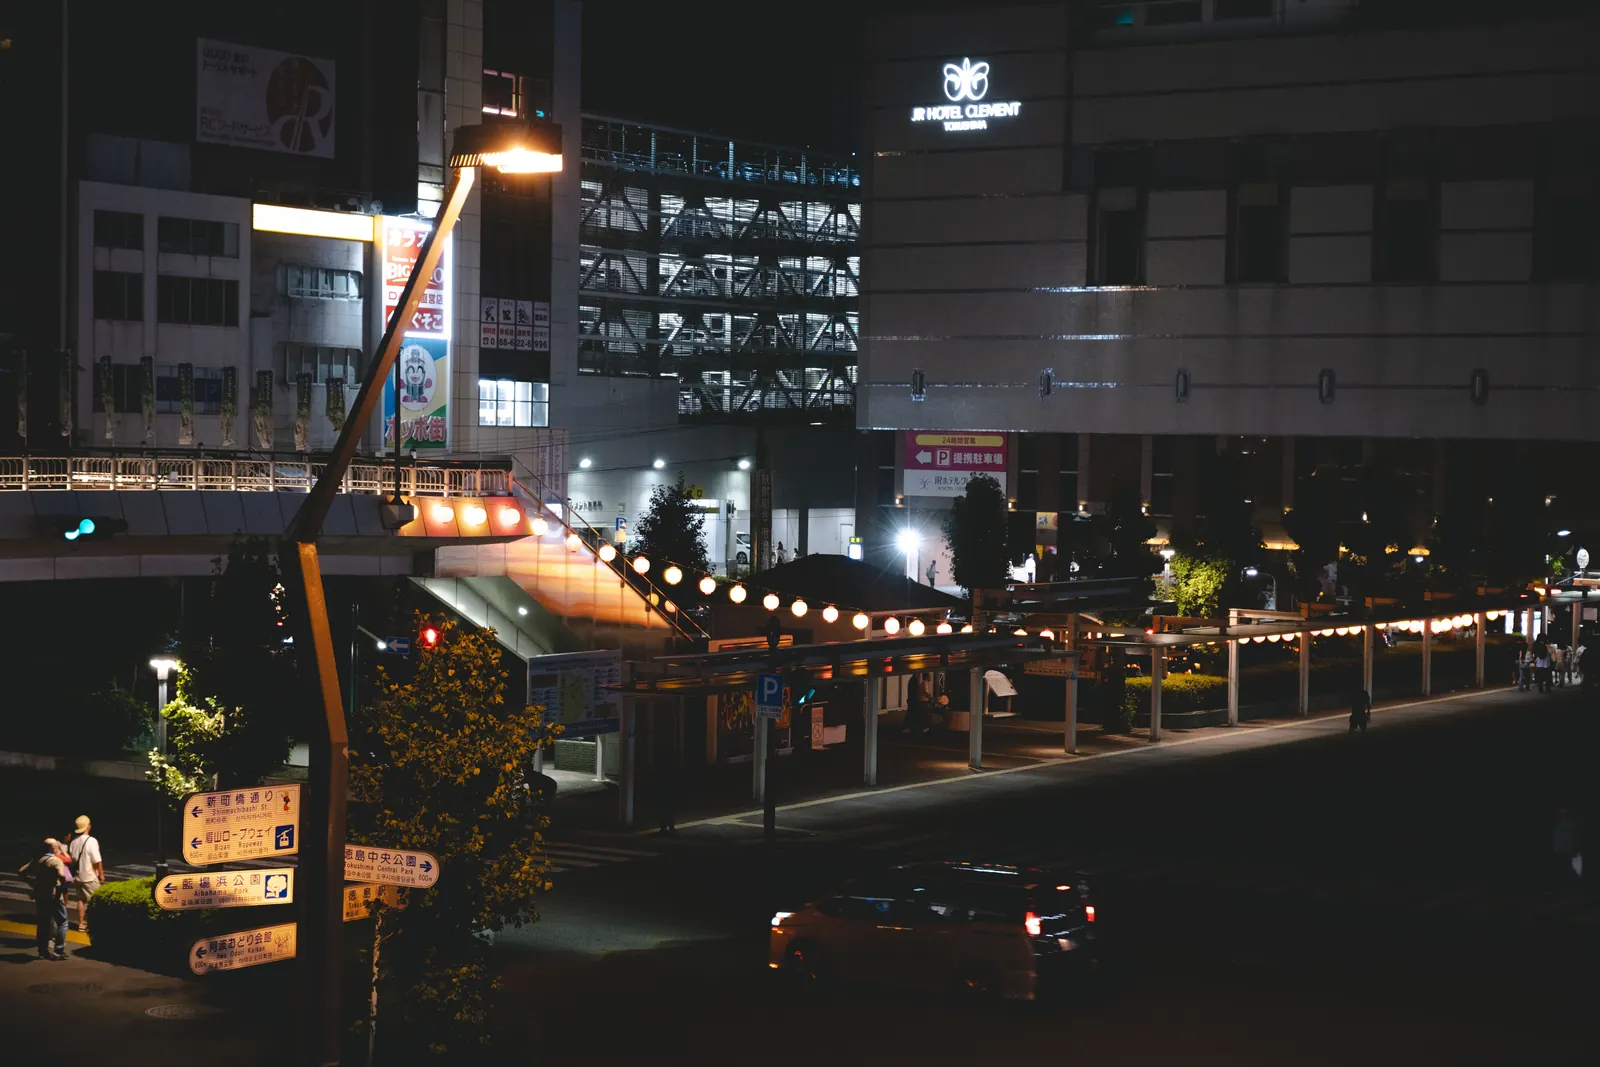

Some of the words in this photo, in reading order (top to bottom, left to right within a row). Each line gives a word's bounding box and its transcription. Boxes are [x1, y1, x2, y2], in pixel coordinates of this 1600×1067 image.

[911, 107, 925, 121] JR
[927, 105, 963, 120] HOTEL
[965, 102, 1021, 118] CLEMENT
[763, 676, 779, 702] P
[207, 790, 273, 807] 新町橋通り
[206, 826, 272, 844] 眉山ロープウェイ
[214, 843, 231, 851] Bizan
[238, 841, 263, 850] Ropeway
[377, 865, 398, 874] Central
[401, 867, 414, 875] Park
[182, 874, 261, 890] 藍場浜公園
[193, 890, 226, 898] Aibahama
[233, 887, 249, 895] Park
[209, 931, 272, 953] 阿波おどり会館
[230, 949, 245, 957] Odori
[247, 946, 265, 954] Kaikan
